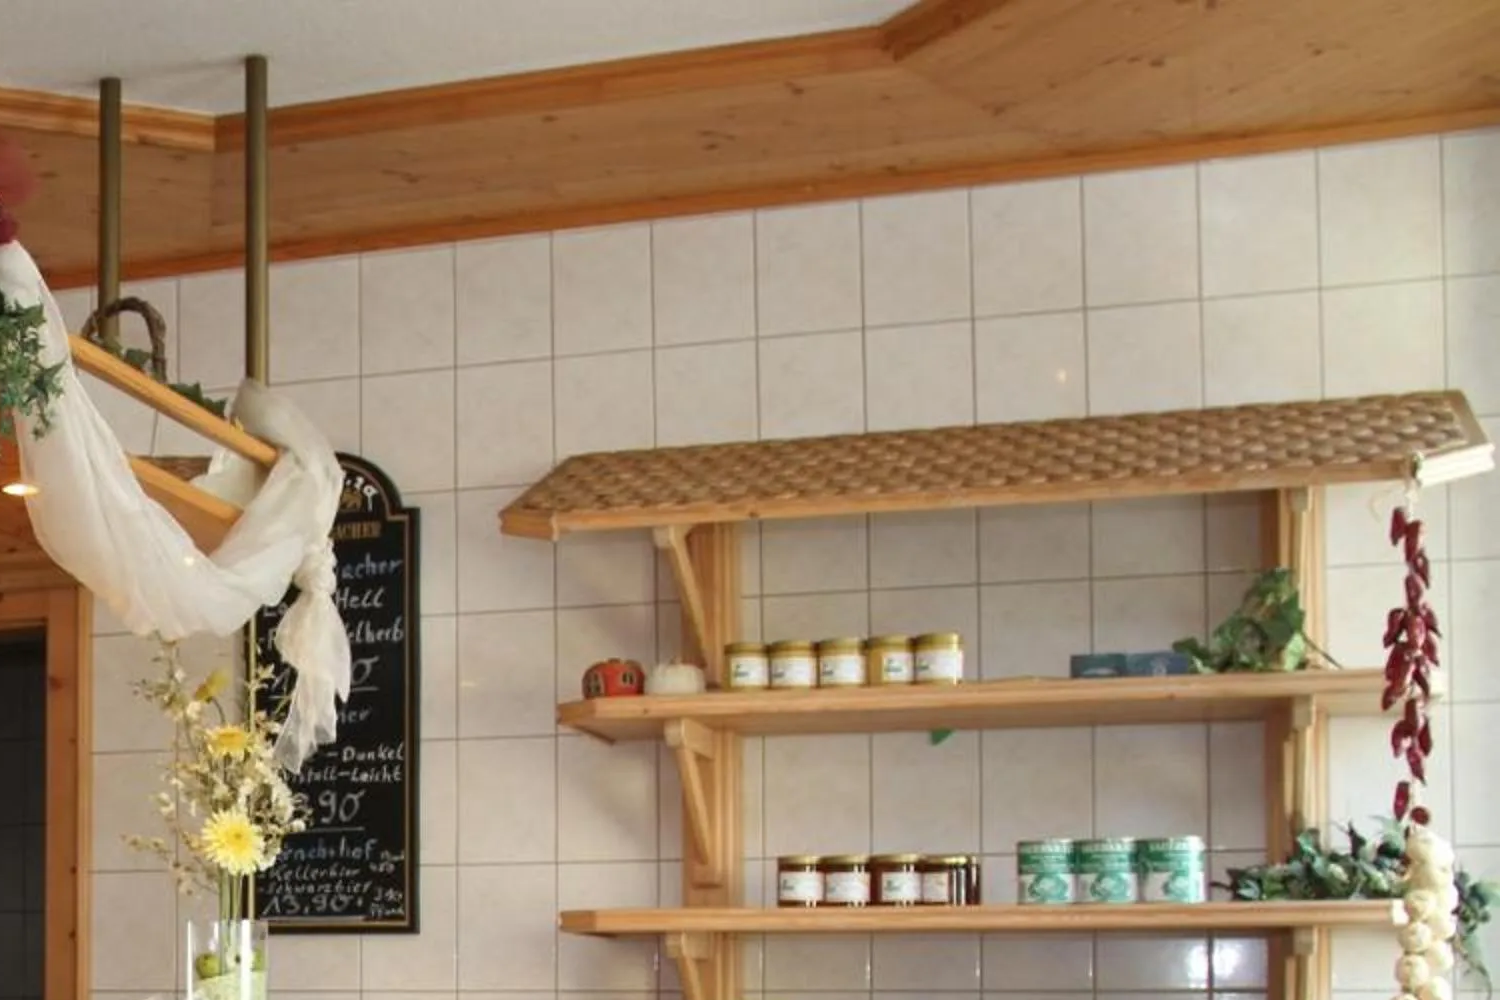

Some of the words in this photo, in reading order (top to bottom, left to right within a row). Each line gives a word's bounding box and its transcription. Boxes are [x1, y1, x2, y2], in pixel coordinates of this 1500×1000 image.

[329, 521, 381, 540] ACHER
[337, 552, 403, 581] acher
[346, 616, 405, 645] elherb
